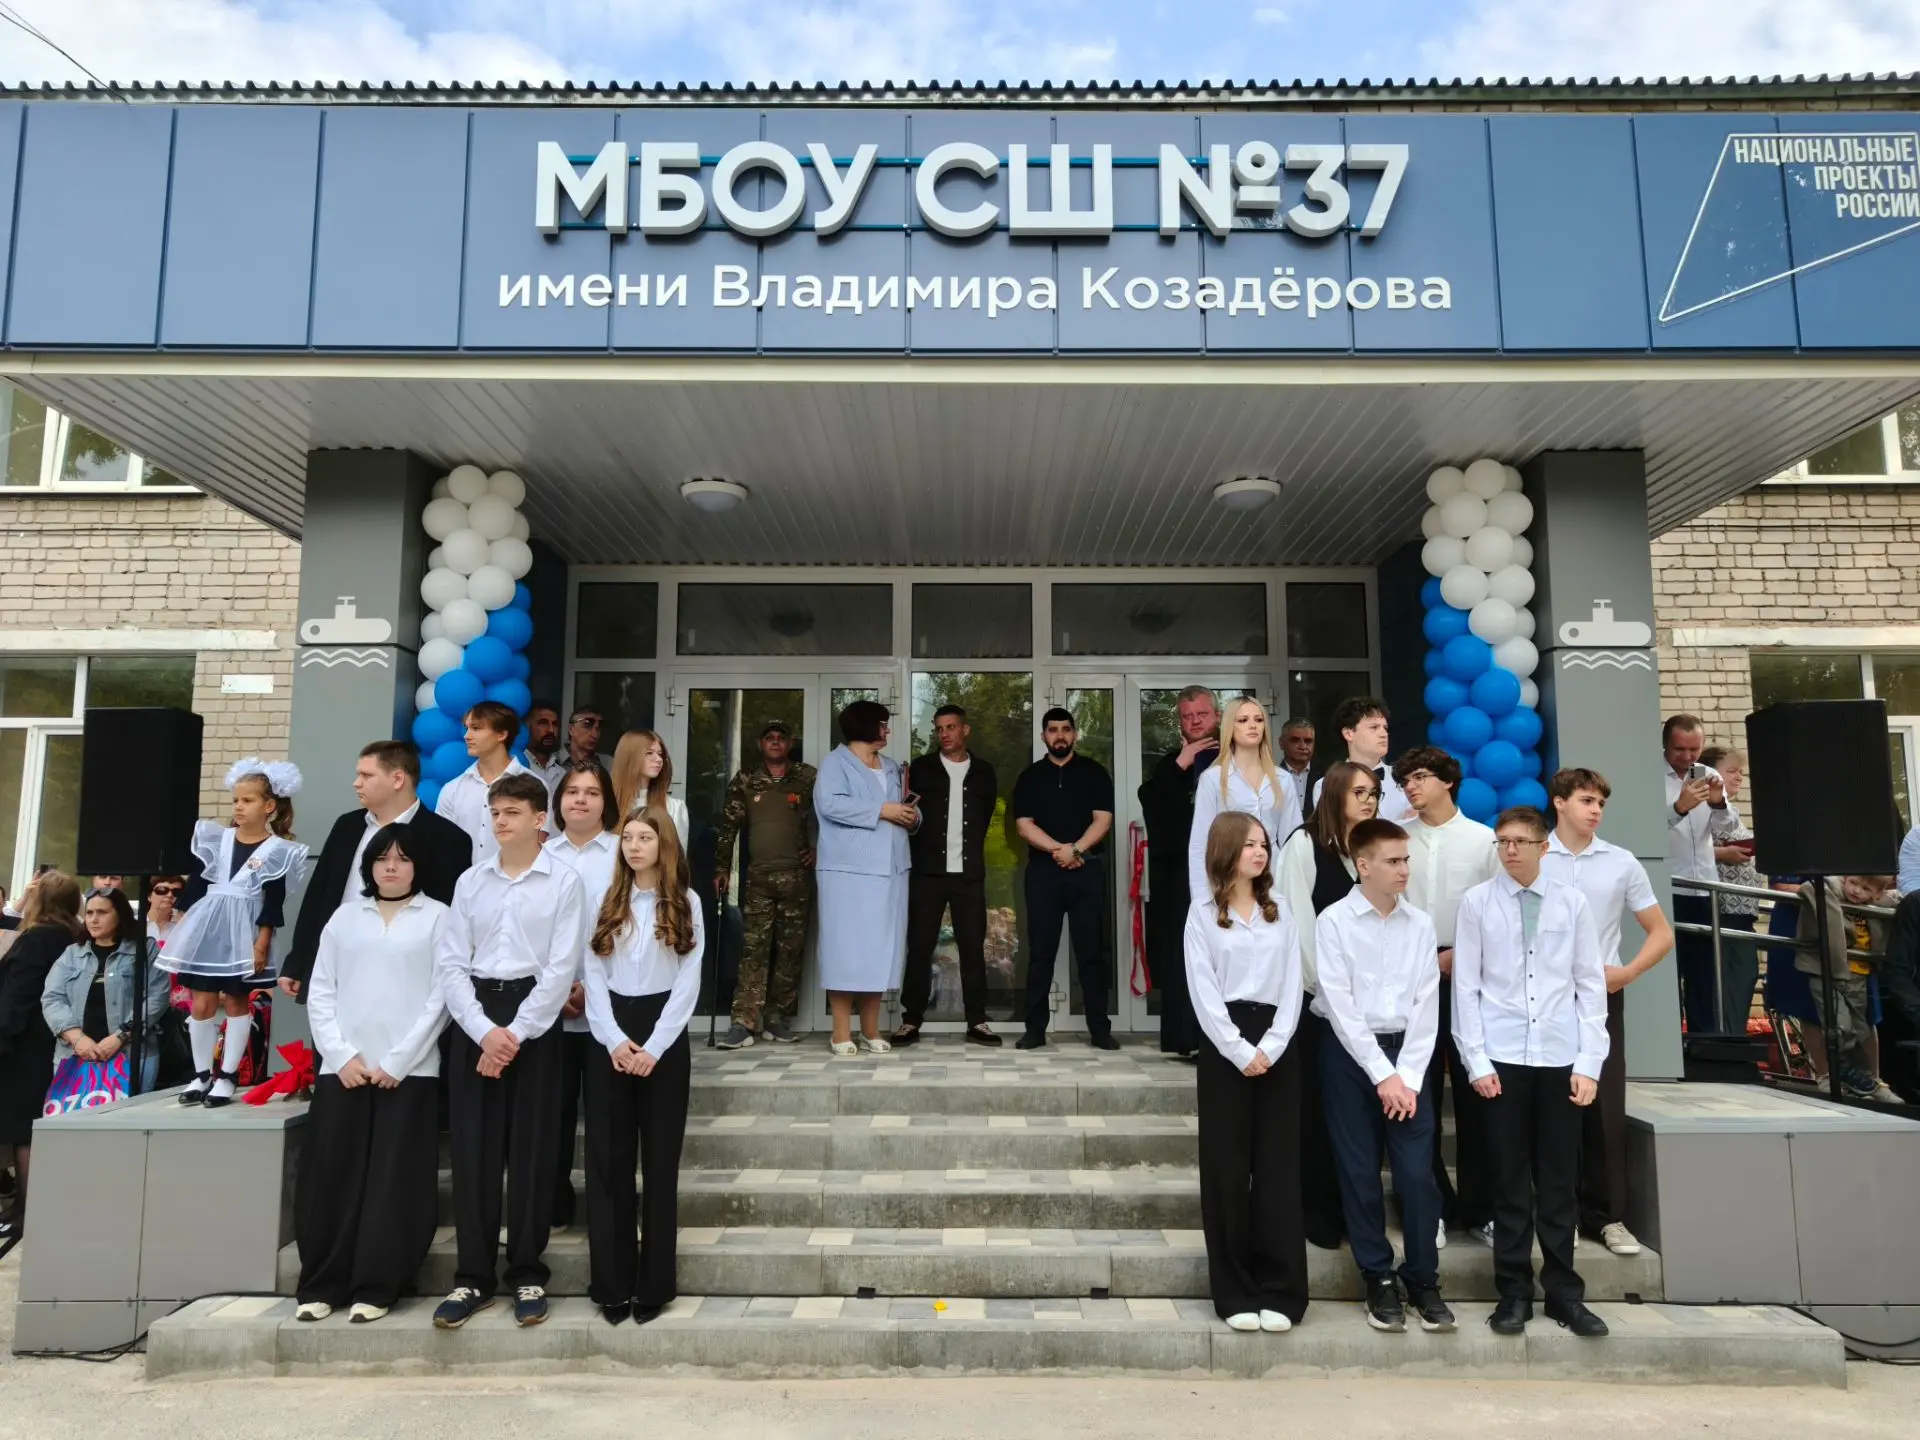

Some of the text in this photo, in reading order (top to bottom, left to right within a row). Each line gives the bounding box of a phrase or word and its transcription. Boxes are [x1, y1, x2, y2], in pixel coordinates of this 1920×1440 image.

[1733, 137, 1916, 166] НАЦИОНАЛЬНЫЕ
[535, 141, 1410, 238] МБОУ СШ №37
[1813, 164, 1919, 190] ПРОЕКТЫ
[1835, 192, 1920, 218] РОССИИ
[499, 264, 1452, 319] имени Владимира Козадёрова
